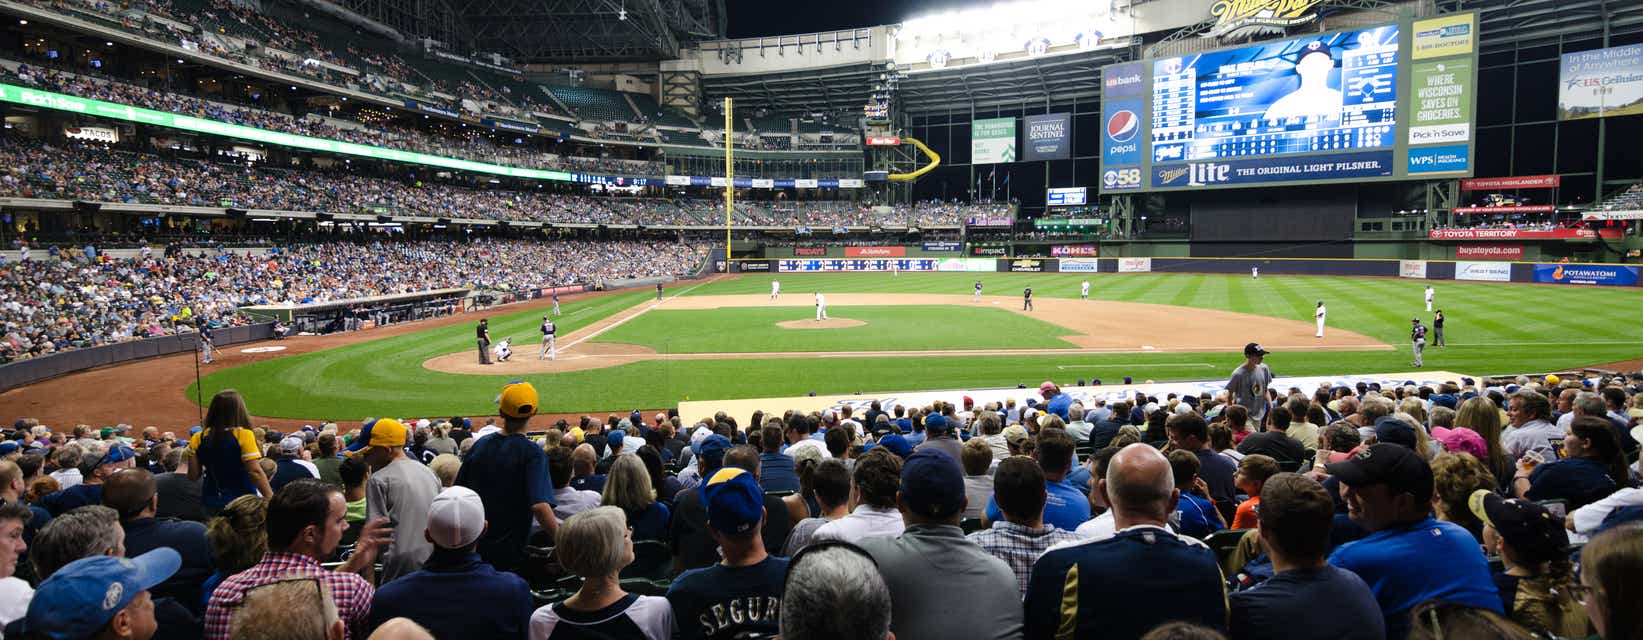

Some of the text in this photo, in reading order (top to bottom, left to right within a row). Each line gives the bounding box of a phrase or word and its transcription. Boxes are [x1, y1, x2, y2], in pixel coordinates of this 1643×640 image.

[1569, 47, 1641, 64] In the Middle
[1569, 58, 1640, 72] of Anywhere
[1427, 73, 1455, 86] WHERE
[1418, 84, 1463, 98] WISCONSIN
[1421, 96, 1459, 109] SAVES ON
[1417, 108, 1462, 121] GROCERIES.
[83, 128, 112, 139] TACOS
[1030, 121, 1065, 133] JOURNAL
[1029, 130, 1065, 140] SENTINEL
[1413, 130, 1432, 139] Pick
[1441, 129, 1465, 137] Save
[1110, 143, 1137, 156] pepsi
[1410, 156, 1434, 165] WPS
[1117, 169, 1141, 184] 58
[1159, 161, 1381, 186] Miller Lite THE ORIGINAL LIGHT PILSNER.
[1501, 179, 1544, 187] HIGHLANDER
[1443, 230, 1473, 238] TOYOTA
[980, 248, 1006, 256] impact
[1459, 246, 1521, 255] buyatoyota.com
[699, 596, 783, 637] SEGUR
